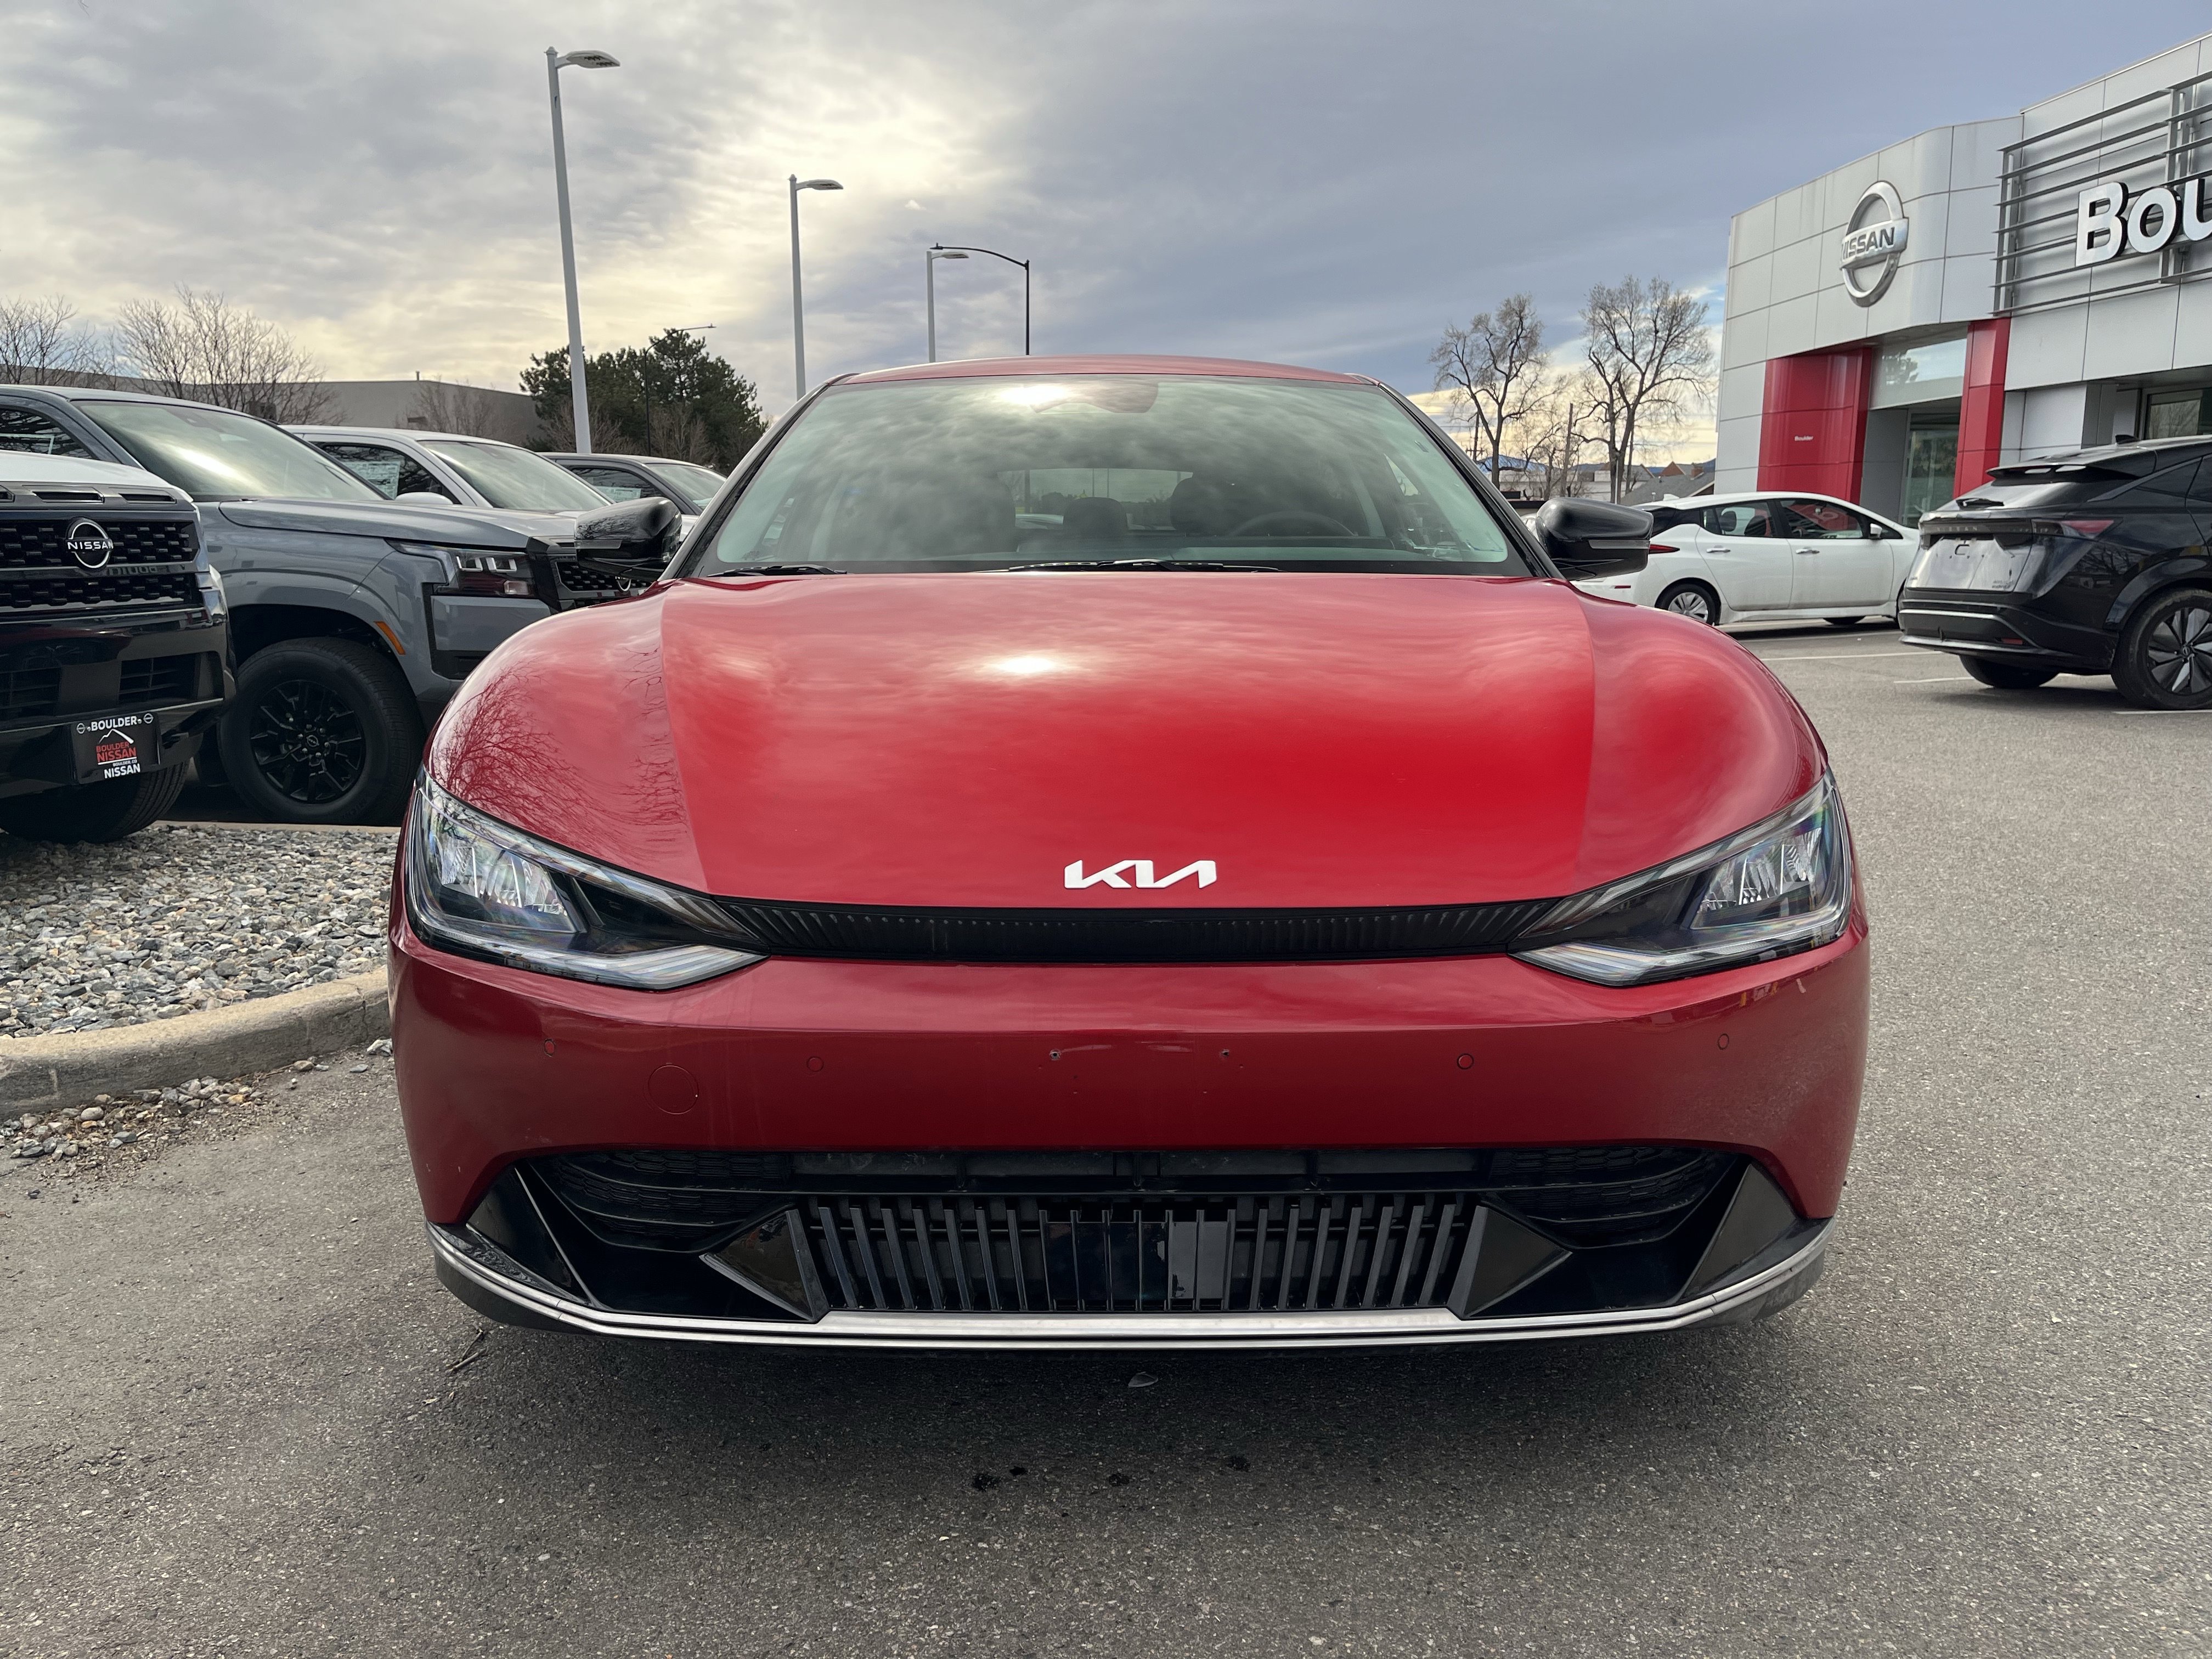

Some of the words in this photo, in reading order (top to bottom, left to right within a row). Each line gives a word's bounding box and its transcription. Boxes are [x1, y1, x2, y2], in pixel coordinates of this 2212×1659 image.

[67, 541, 114, 550] NISSAN
[91, 716, 137, 731] BOULDER
[96, 742, 129, 753] BOULDER
[97, 747, 137, 763] NISSAN
[104, 763, 141, 778] NISSAN
[1064, 860, 1217, 889] KIA
